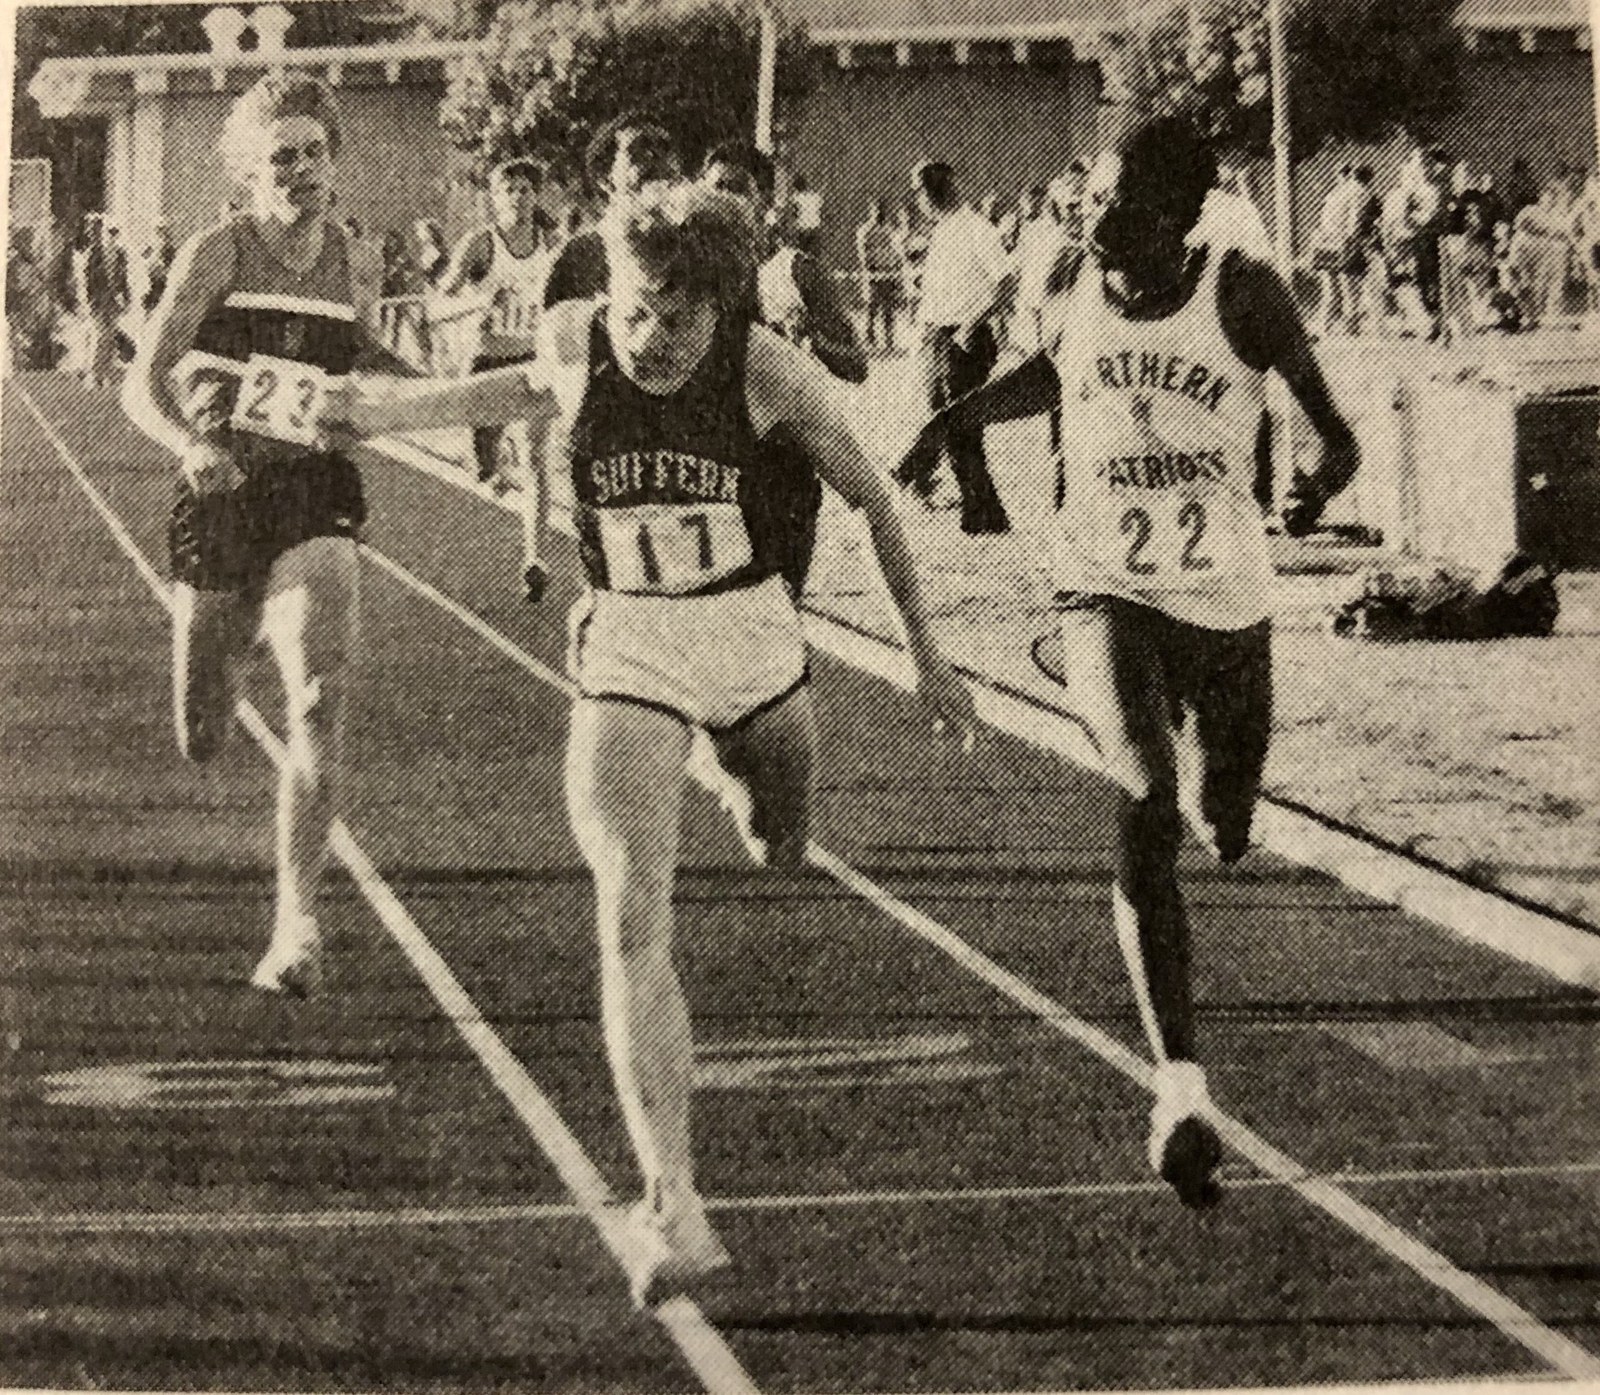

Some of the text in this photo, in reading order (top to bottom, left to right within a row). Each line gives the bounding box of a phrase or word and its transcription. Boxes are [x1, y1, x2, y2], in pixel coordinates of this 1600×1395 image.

[245, 368, 317, 428] 23
[1079, 350, 1232, 412] RTHERN
[590, 449, 741, 504] SUFFERN
[1097, 448, 1228, 490] ATRIOTS
[636, 513, 713, 583] 17
[1119, 500, 1213, 575] 22
